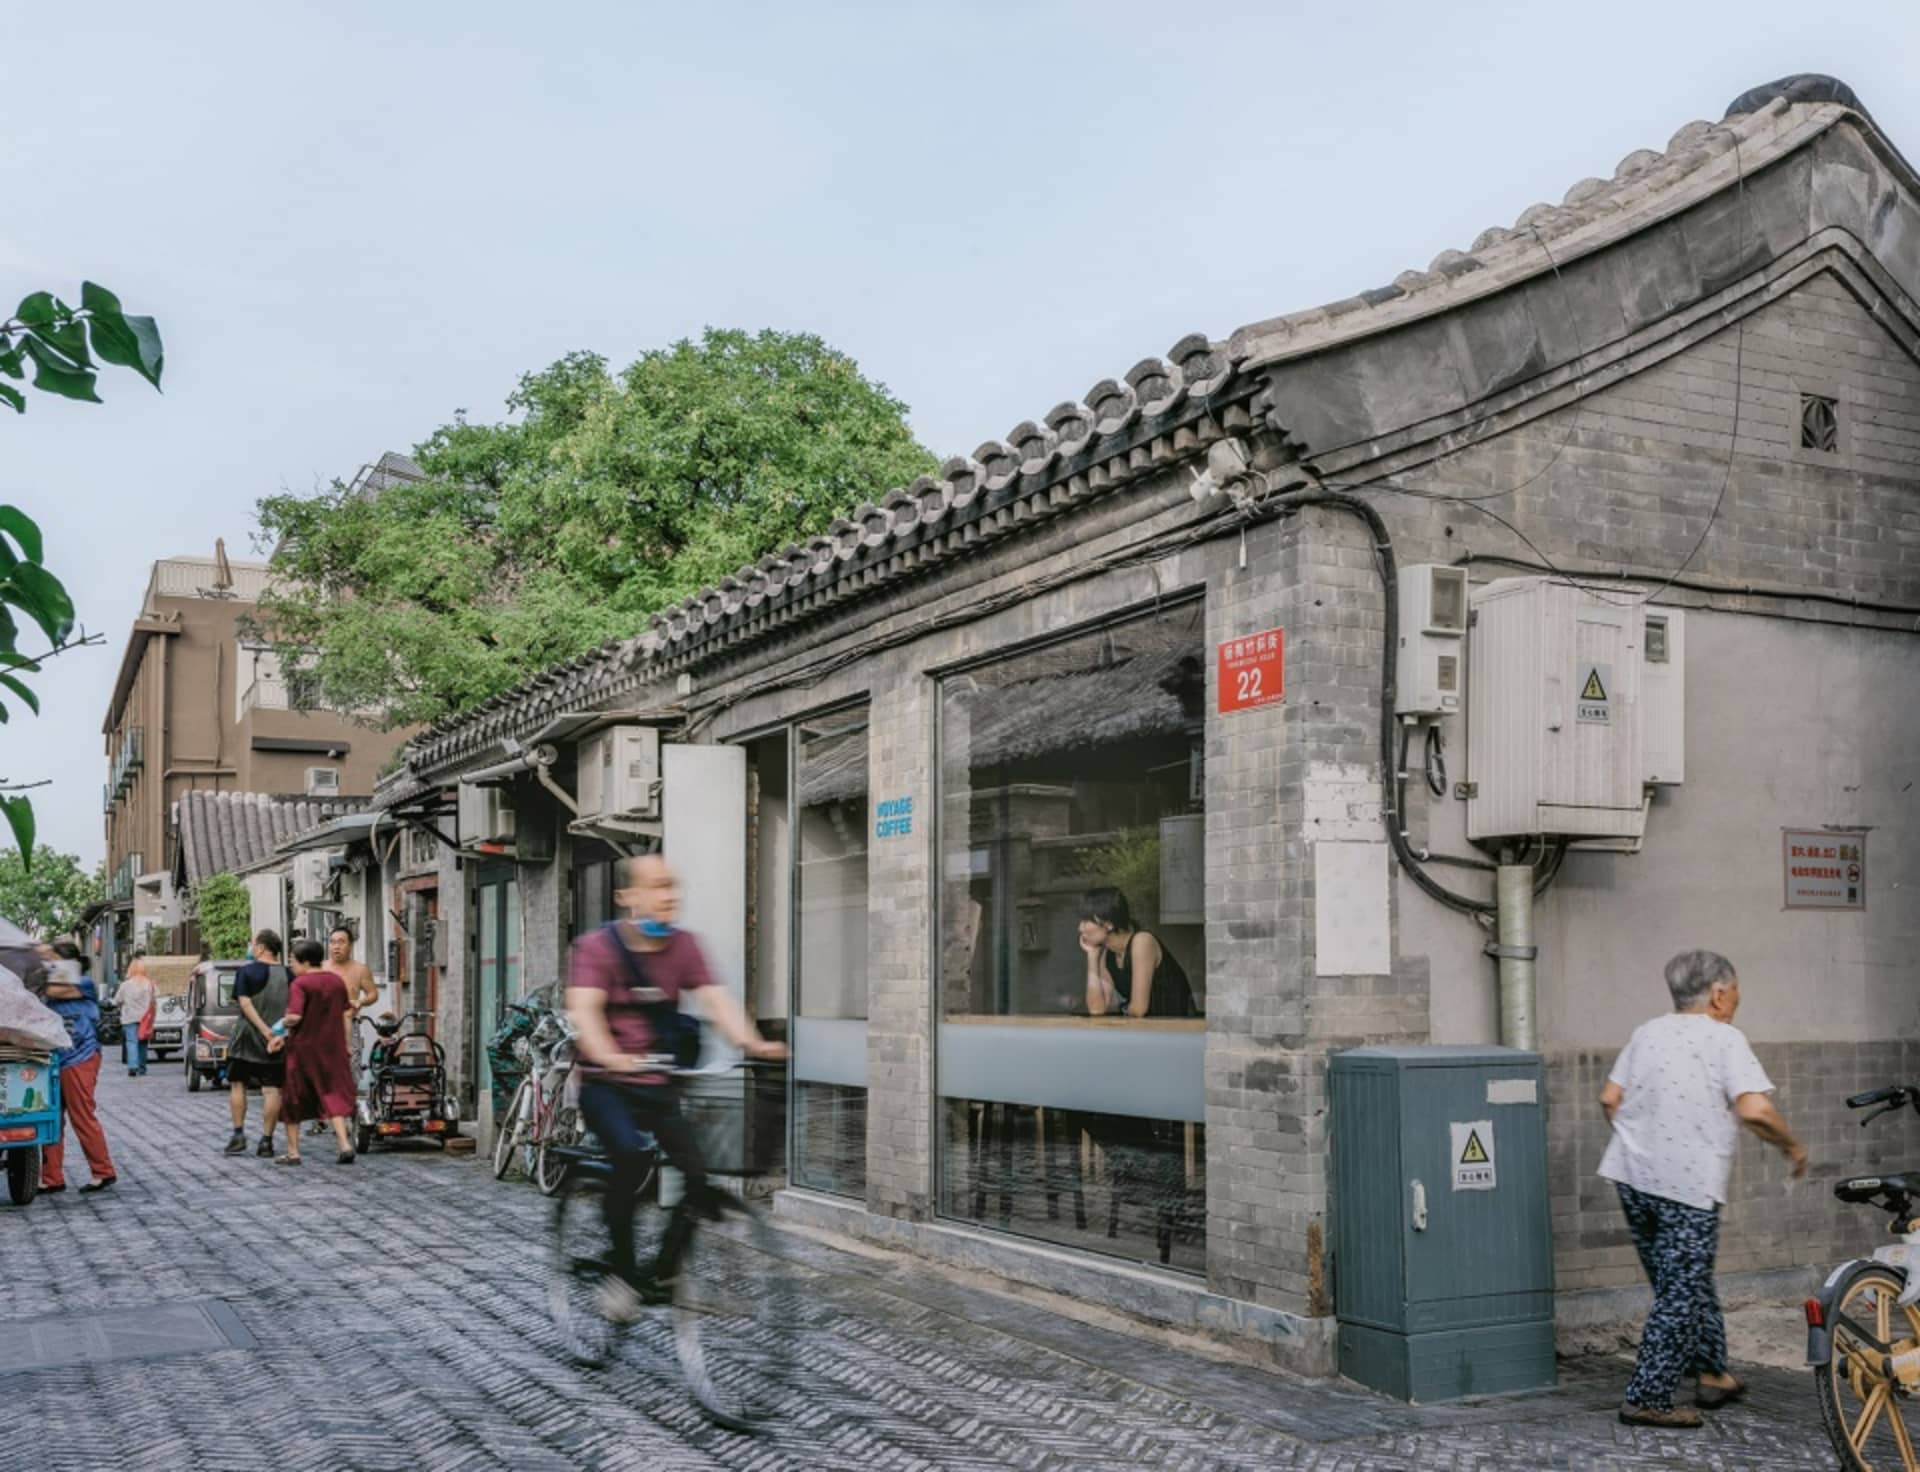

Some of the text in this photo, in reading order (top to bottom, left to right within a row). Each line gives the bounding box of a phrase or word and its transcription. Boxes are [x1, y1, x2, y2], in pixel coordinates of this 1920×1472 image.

[1224, 633, 1278, 661] 杨梅竹斜街
[1237, 667, 1262, 701] 22
[876, 796, 913, 817] VOYAGE
[876, 816, 913, 838] COFFEE
